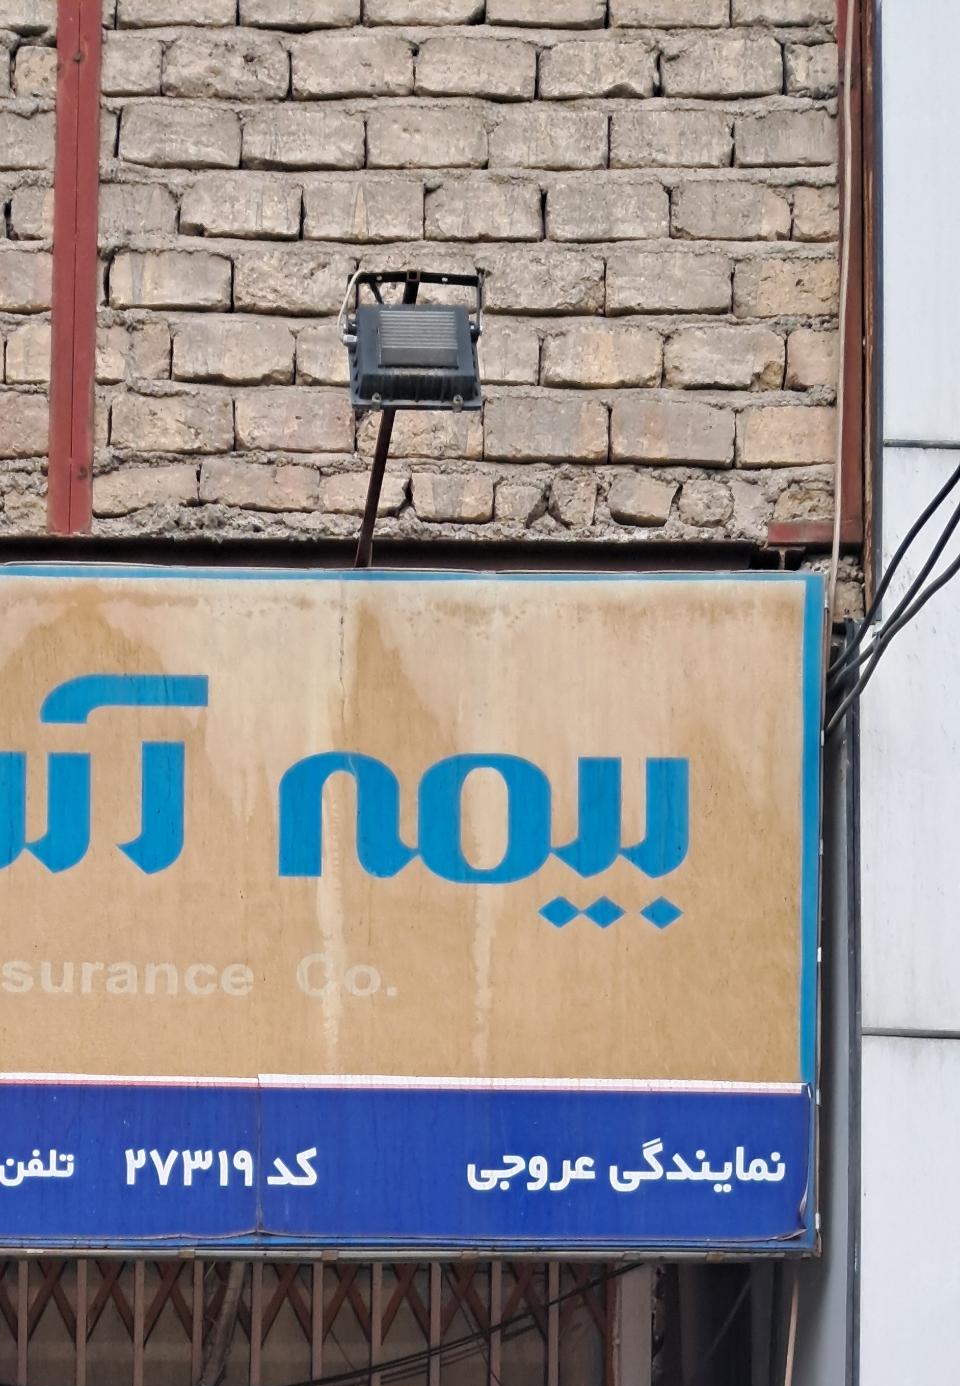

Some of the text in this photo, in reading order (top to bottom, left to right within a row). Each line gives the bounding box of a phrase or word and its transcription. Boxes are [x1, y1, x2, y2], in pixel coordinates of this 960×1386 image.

[279, 752, 688, 928] بیمه
[295, 952, 397, 997] Co.
[124, 1148, 253, 1187] ۲۷۳۱۹
[267, 1147, 318, 1186] کد
[467, 1150, 596, 1191] عروجی
[610, 1138, 786, 1193] نمایندگی
